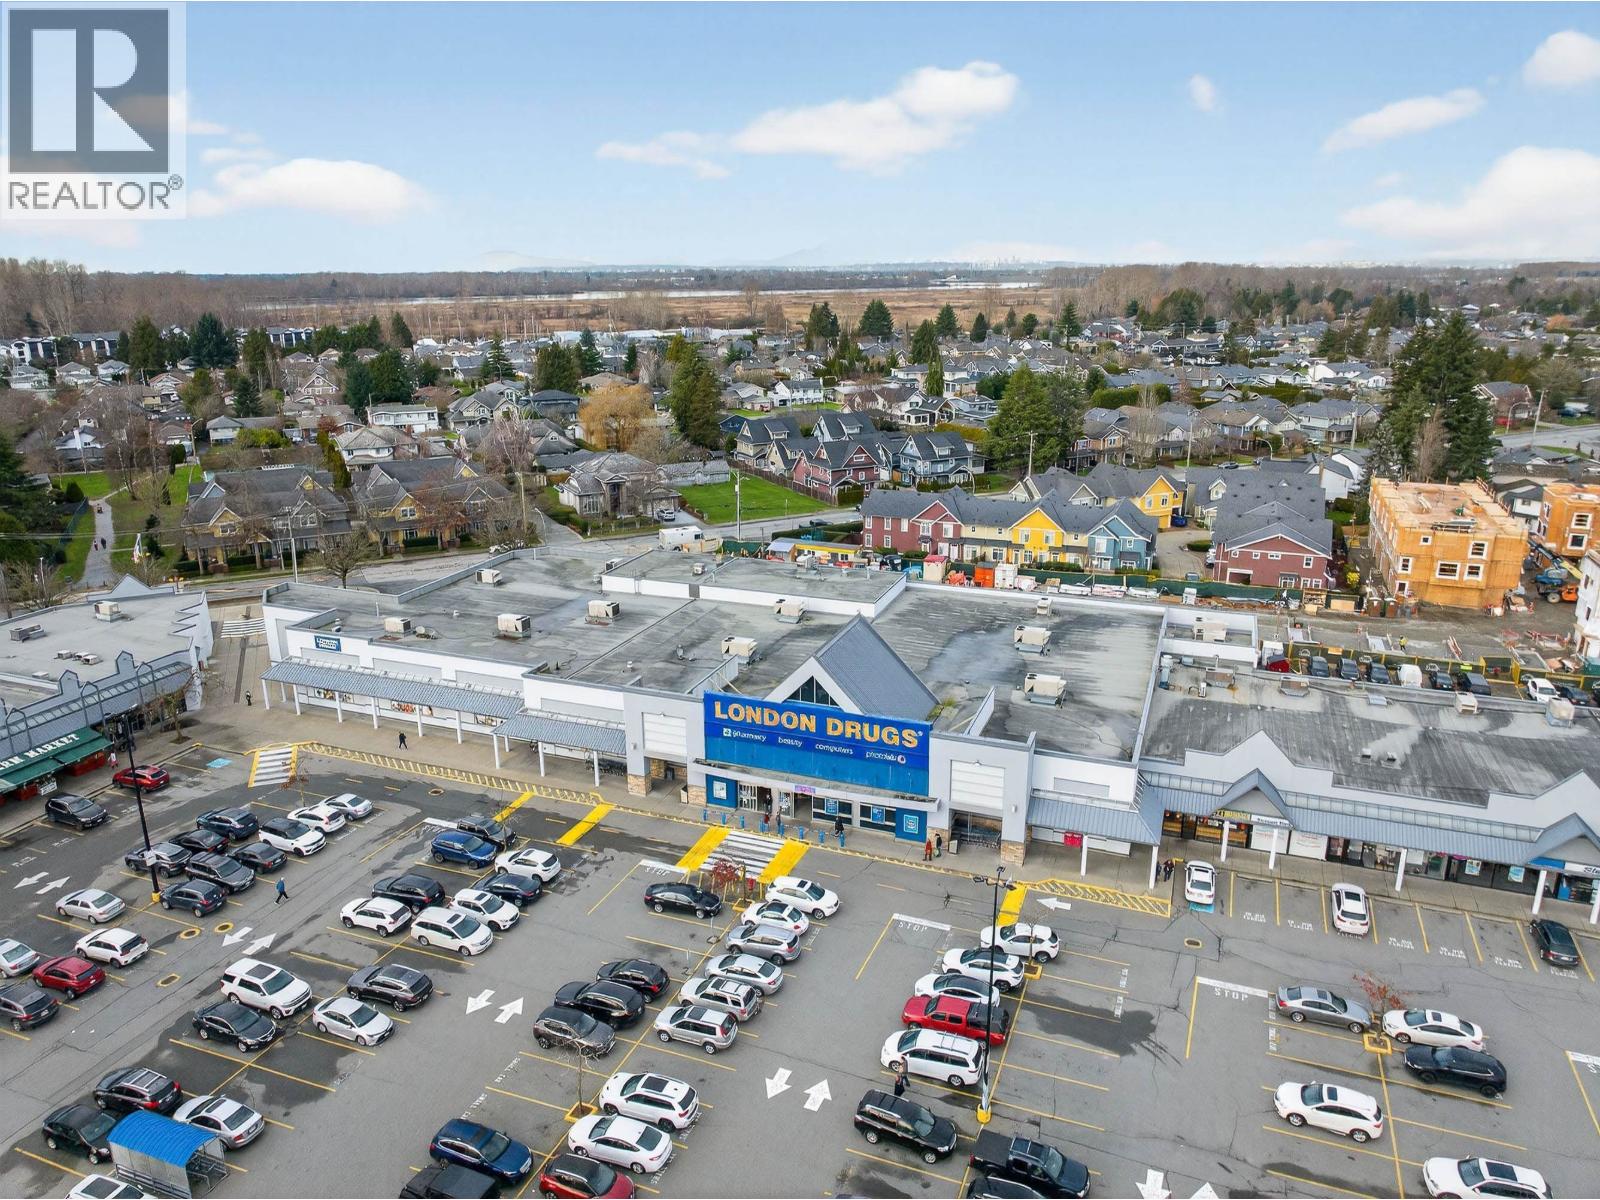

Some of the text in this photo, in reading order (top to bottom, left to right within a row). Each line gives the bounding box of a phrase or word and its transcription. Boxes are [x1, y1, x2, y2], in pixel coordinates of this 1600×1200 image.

[714, 701, 816, 733] LONDON
[24, 733, 80, 758] MARKET
[1213, 986, 1249, 1001] STOP
